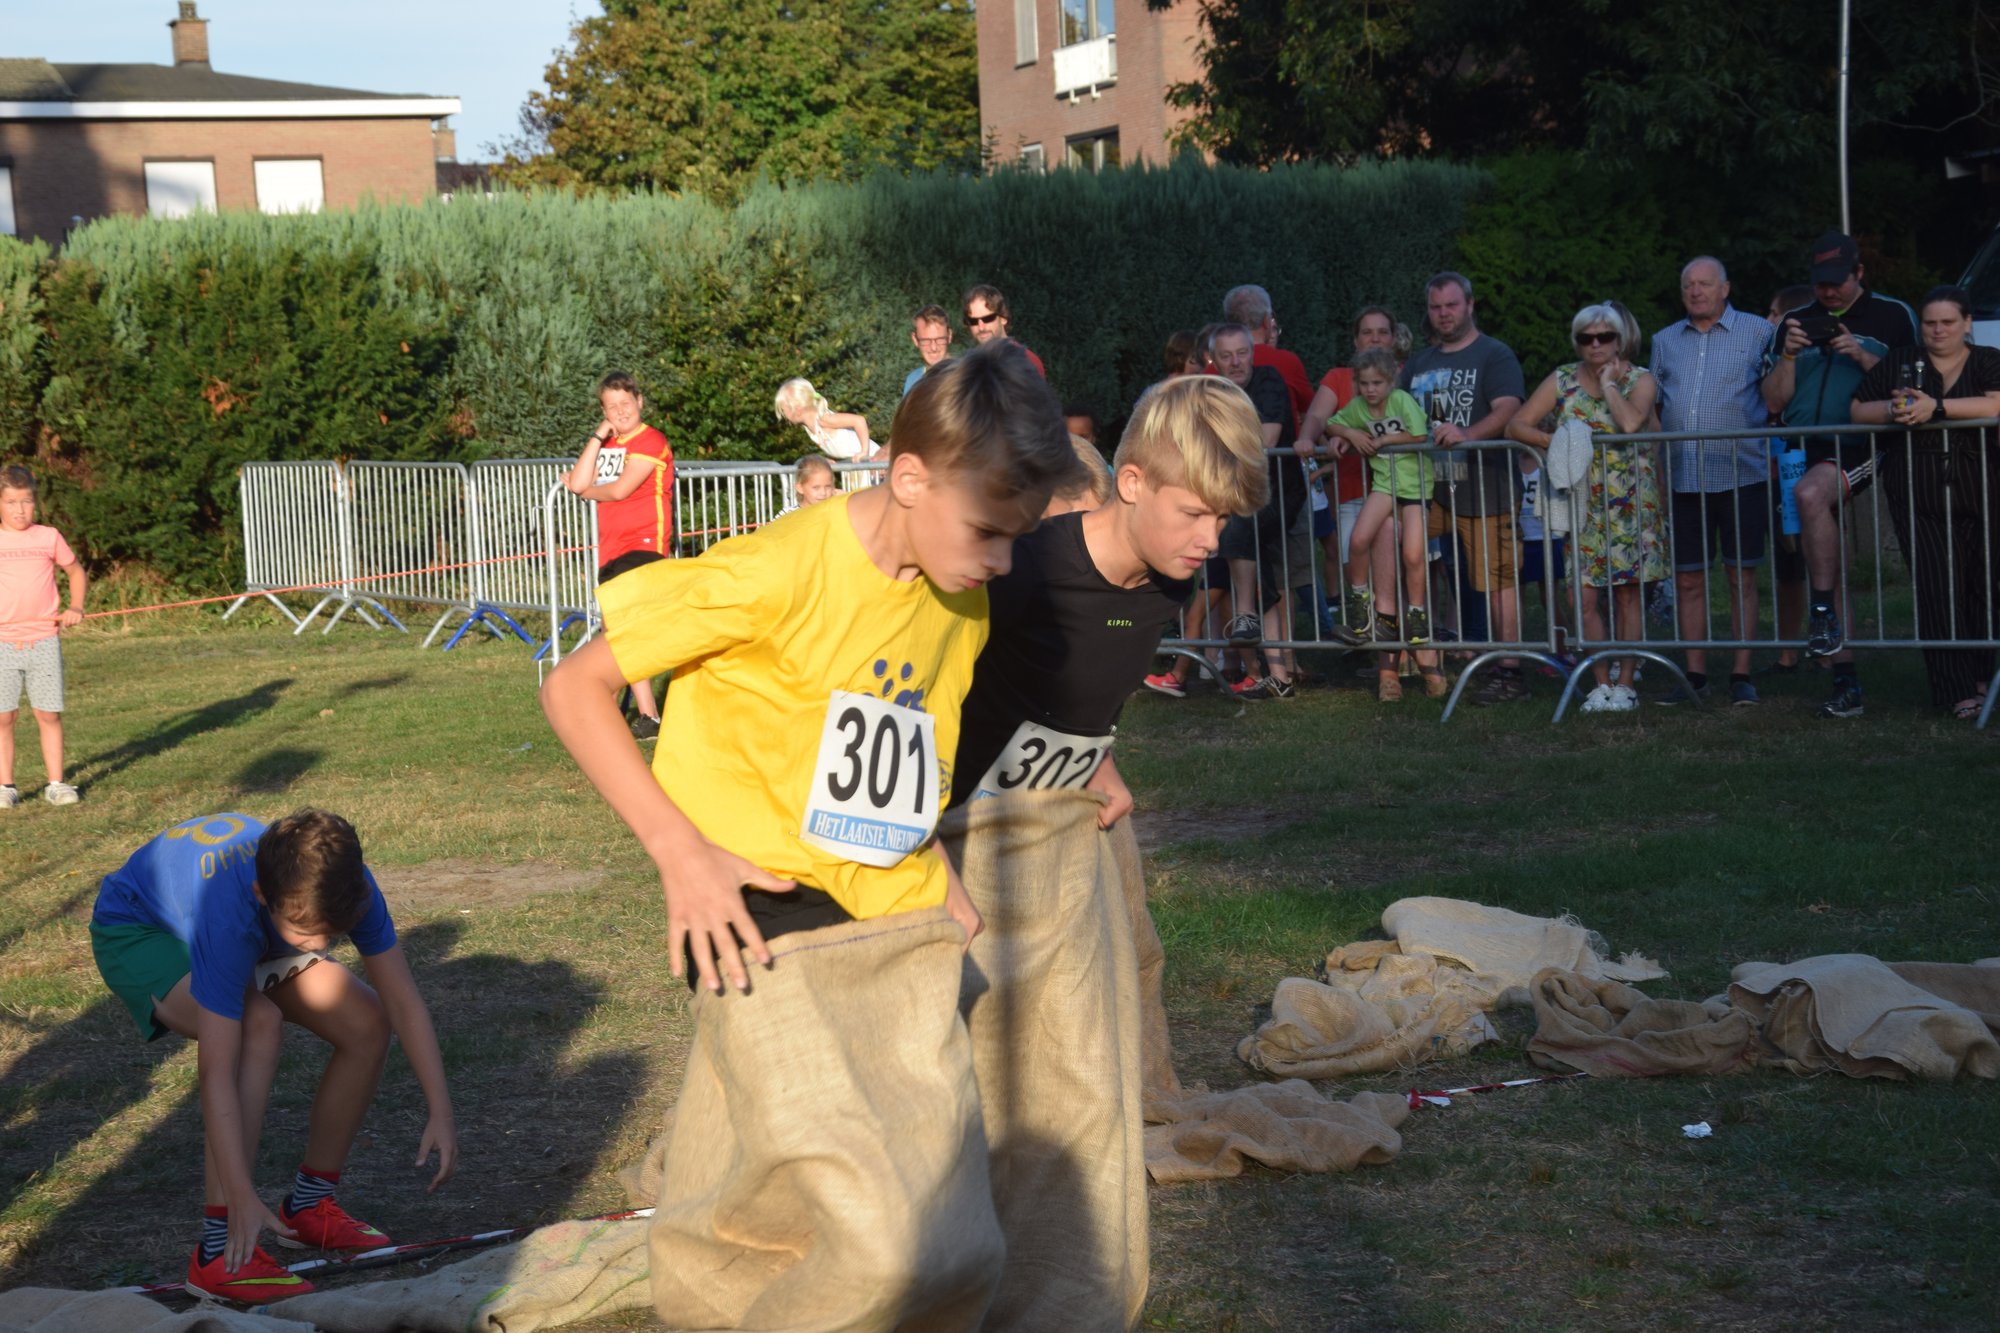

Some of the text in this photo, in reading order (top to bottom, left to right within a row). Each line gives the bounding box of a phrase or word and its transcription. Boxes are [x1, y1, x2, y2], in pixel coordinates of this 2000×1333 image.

[598, 453, 622, 476] 252
[828, 707, 926, 814] 301
[997, 737, 1097, 791] 302
[814, 813, 841, 839] HET
[840, 817, 884, 847] LAATSTE
[200, 840, 258, 878] NHO
